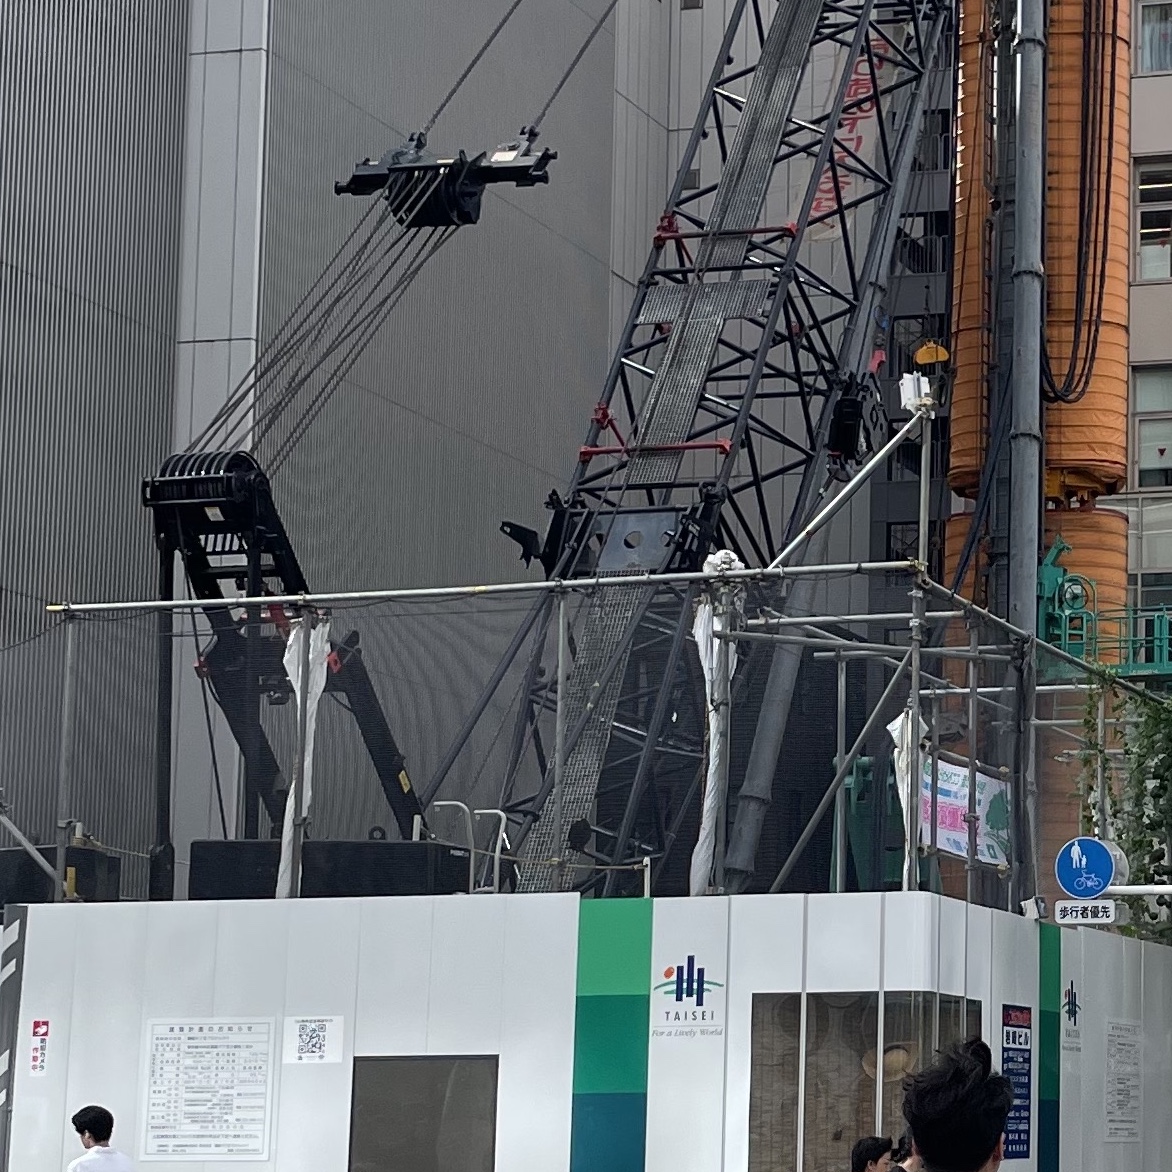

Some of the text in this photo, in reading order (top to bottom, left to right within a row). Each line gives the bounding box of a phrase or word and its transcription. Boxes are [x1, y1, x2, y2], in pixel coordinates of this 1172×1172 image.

[1059, 905, 1111, 920] 歩行者優先
[664, 1010, 715, 1021] TAISEI
